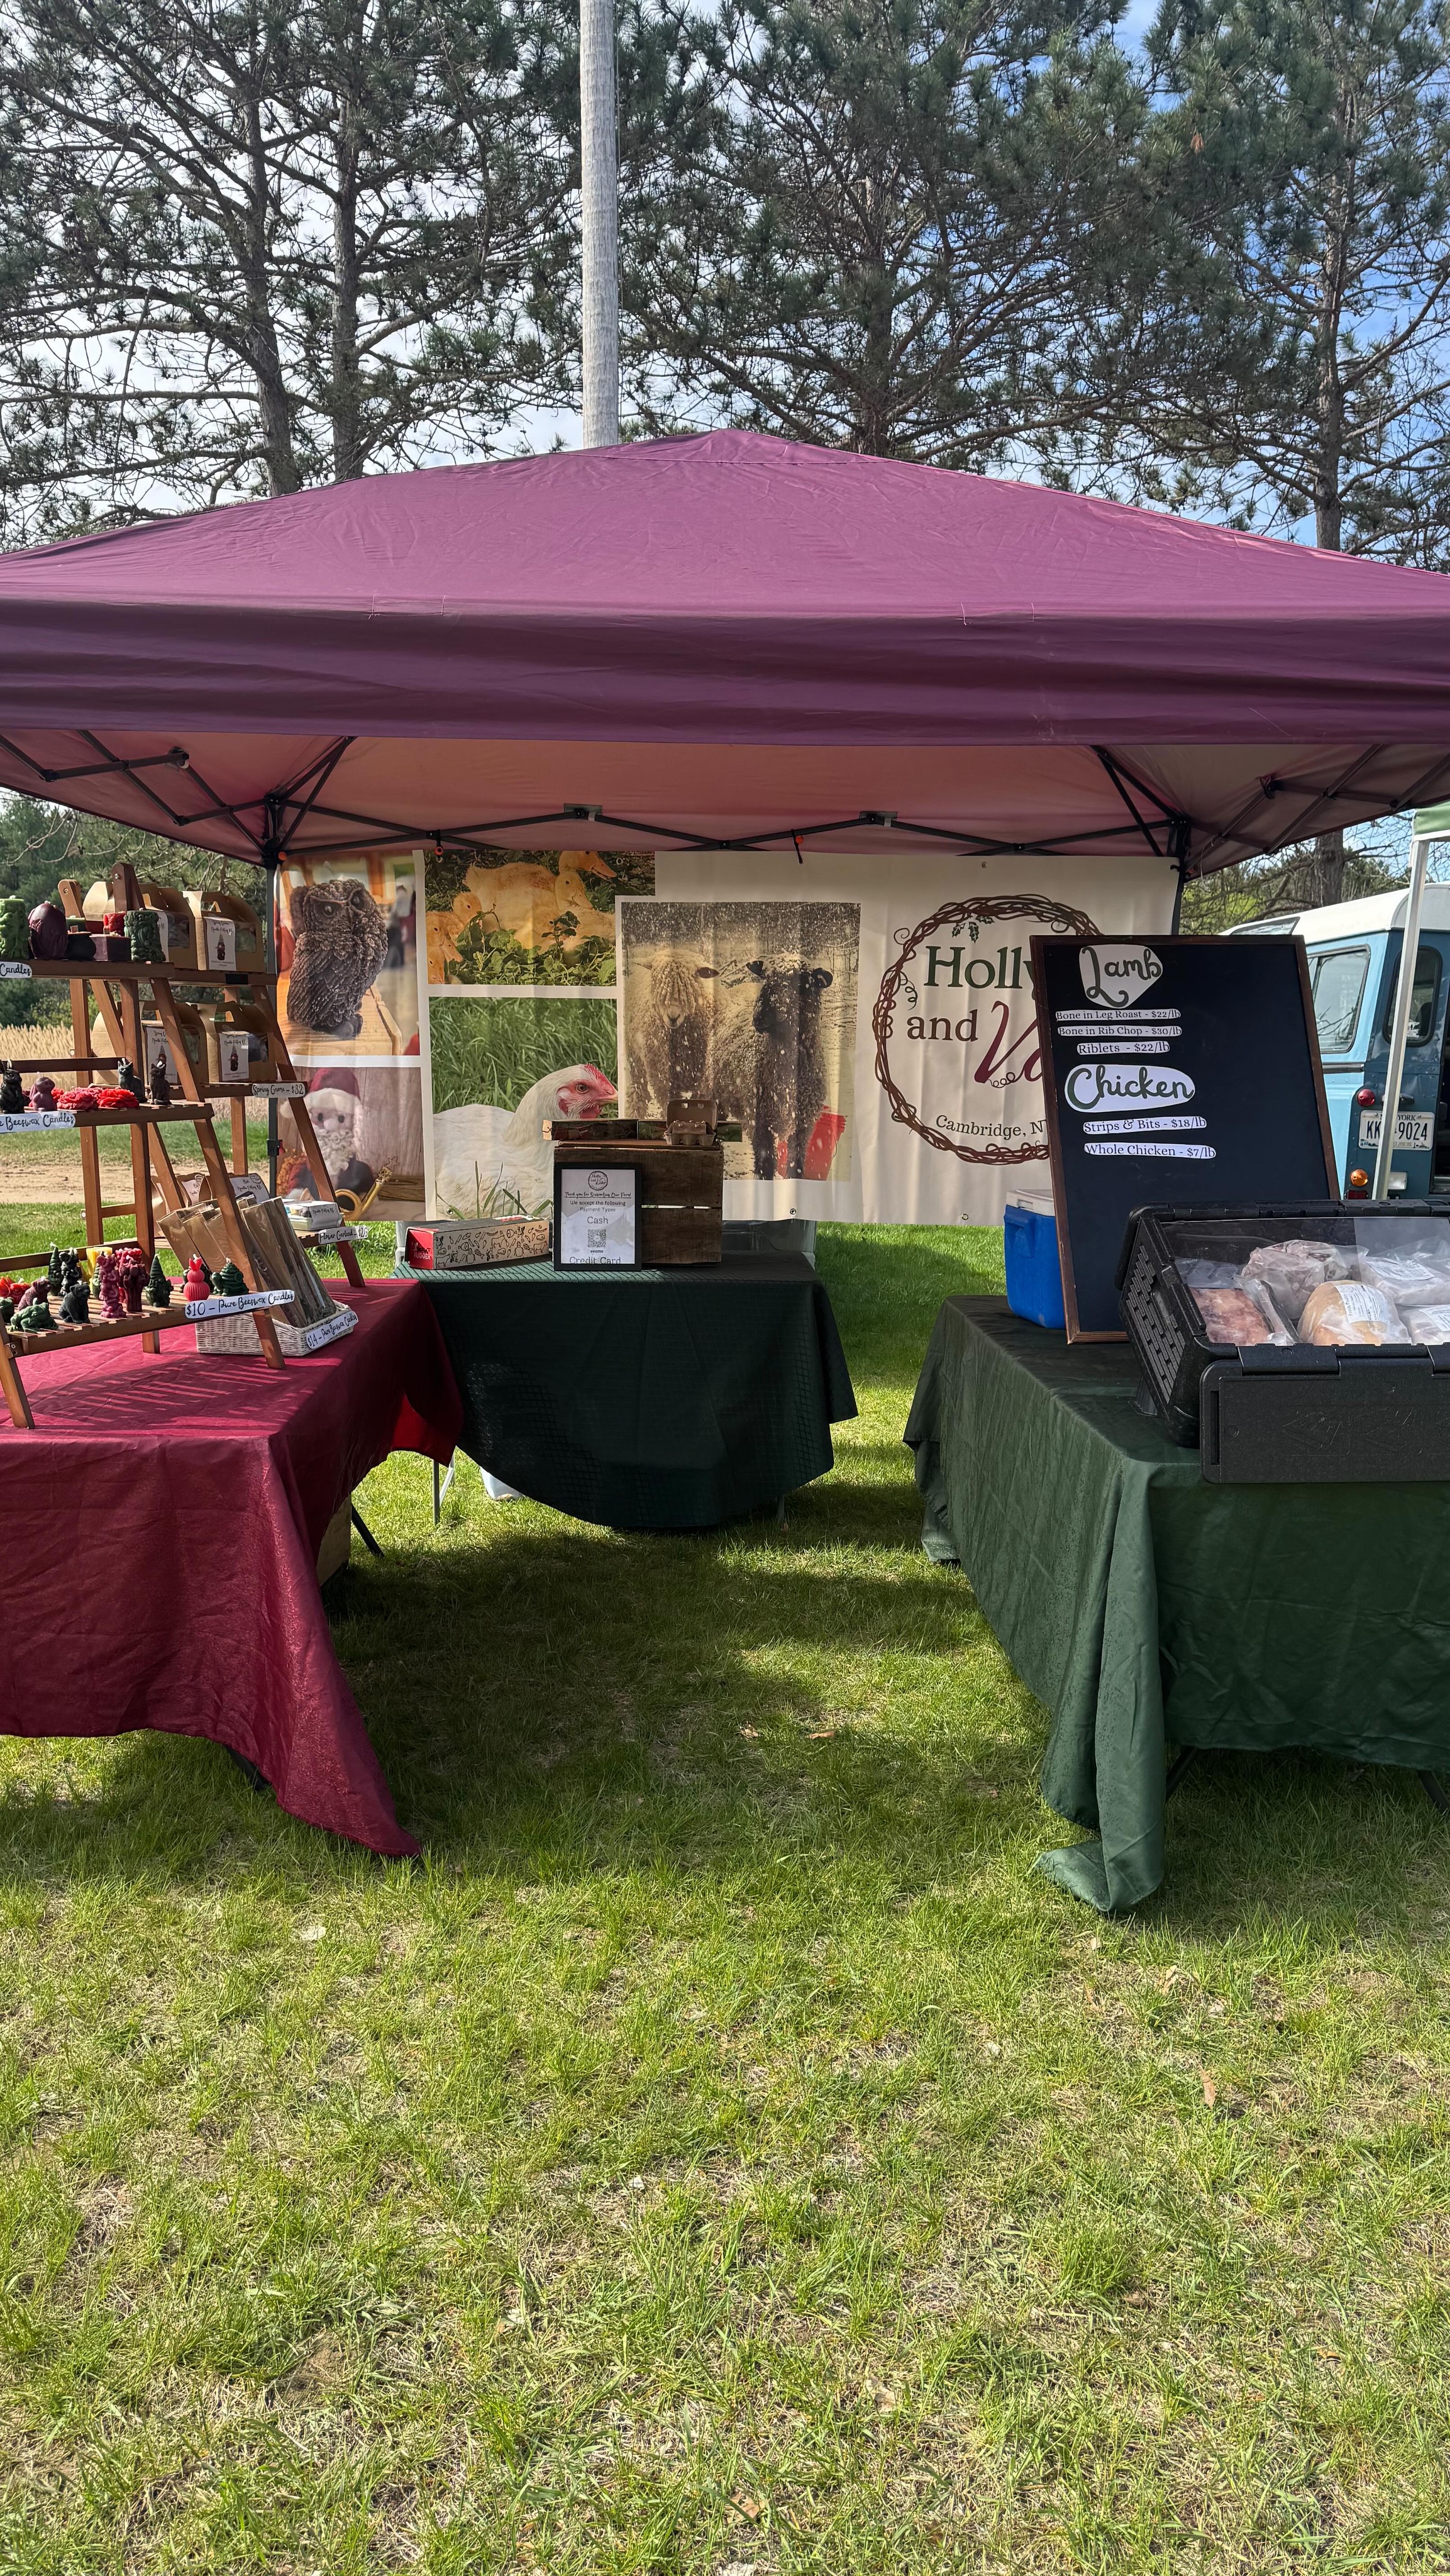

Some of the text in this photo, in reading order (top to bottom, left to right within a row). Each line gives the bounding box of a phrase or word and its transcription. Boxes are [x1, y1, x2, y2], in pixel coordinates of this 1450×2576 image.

[0, 963, 31, 976] Candles
[1082, 946, 1162, 1008] Lamb
[1056, 1011, 1080, 1019] Bone
[1083, 1011, 1093, 1019] in
[1095, 1011, 1113, 1020] Leg
[1115, 1010, 1143, 1018] Roast
[1151, 1009, 1180, 1019] $22/lb
[907, 1009, 978, 1042] and
[1059, 1027, 1083, 1035] Bone
[1086, 1026, 1095, 1035] in
[1098, 1026, 1114, 1035] Rib
[1117, 1026, 1143, 1036] Chop
[1152, 1027, 1182, 1036] $30/lb
[1078, 1043, 1120, 1053] Riblets
[1134, 1041, 1170, 1053] $22/lb
[253, 1084, 269, 1096] Spring
[291, 1083, 304, 1095] $32
[1067, 1065, 1194, 1109] Chicken
[6, 1112, 74, 1131] Beeswax Candles
[936, 1114, 1047, 1140] Cambridge, N
[1085, 1121, 1119, 1133] Strips
[1123, 1119, 1134, 1130] &
[1137, 1119, 1160, 1129] Bits
[1171, 1116, 1206, 1130] $18/lb
[1085, 1144, 1124, 1155] Whole
[1127, 1145, 1176, 1156] Chicken
[1187, 1146, 1216, 1159] $7/lb
[319, 1231, 335, 1243] Flower
[570, 1256, 597, 1264] Credit
[186, 1302, 206, 1316] $10
[218, 1299, 236, 1313] Pure
[238, 1297, 265, 1310] Beeswax
[268, 1291, 294, 1305] Candles
[307, 1334, 318, 1347] $14
